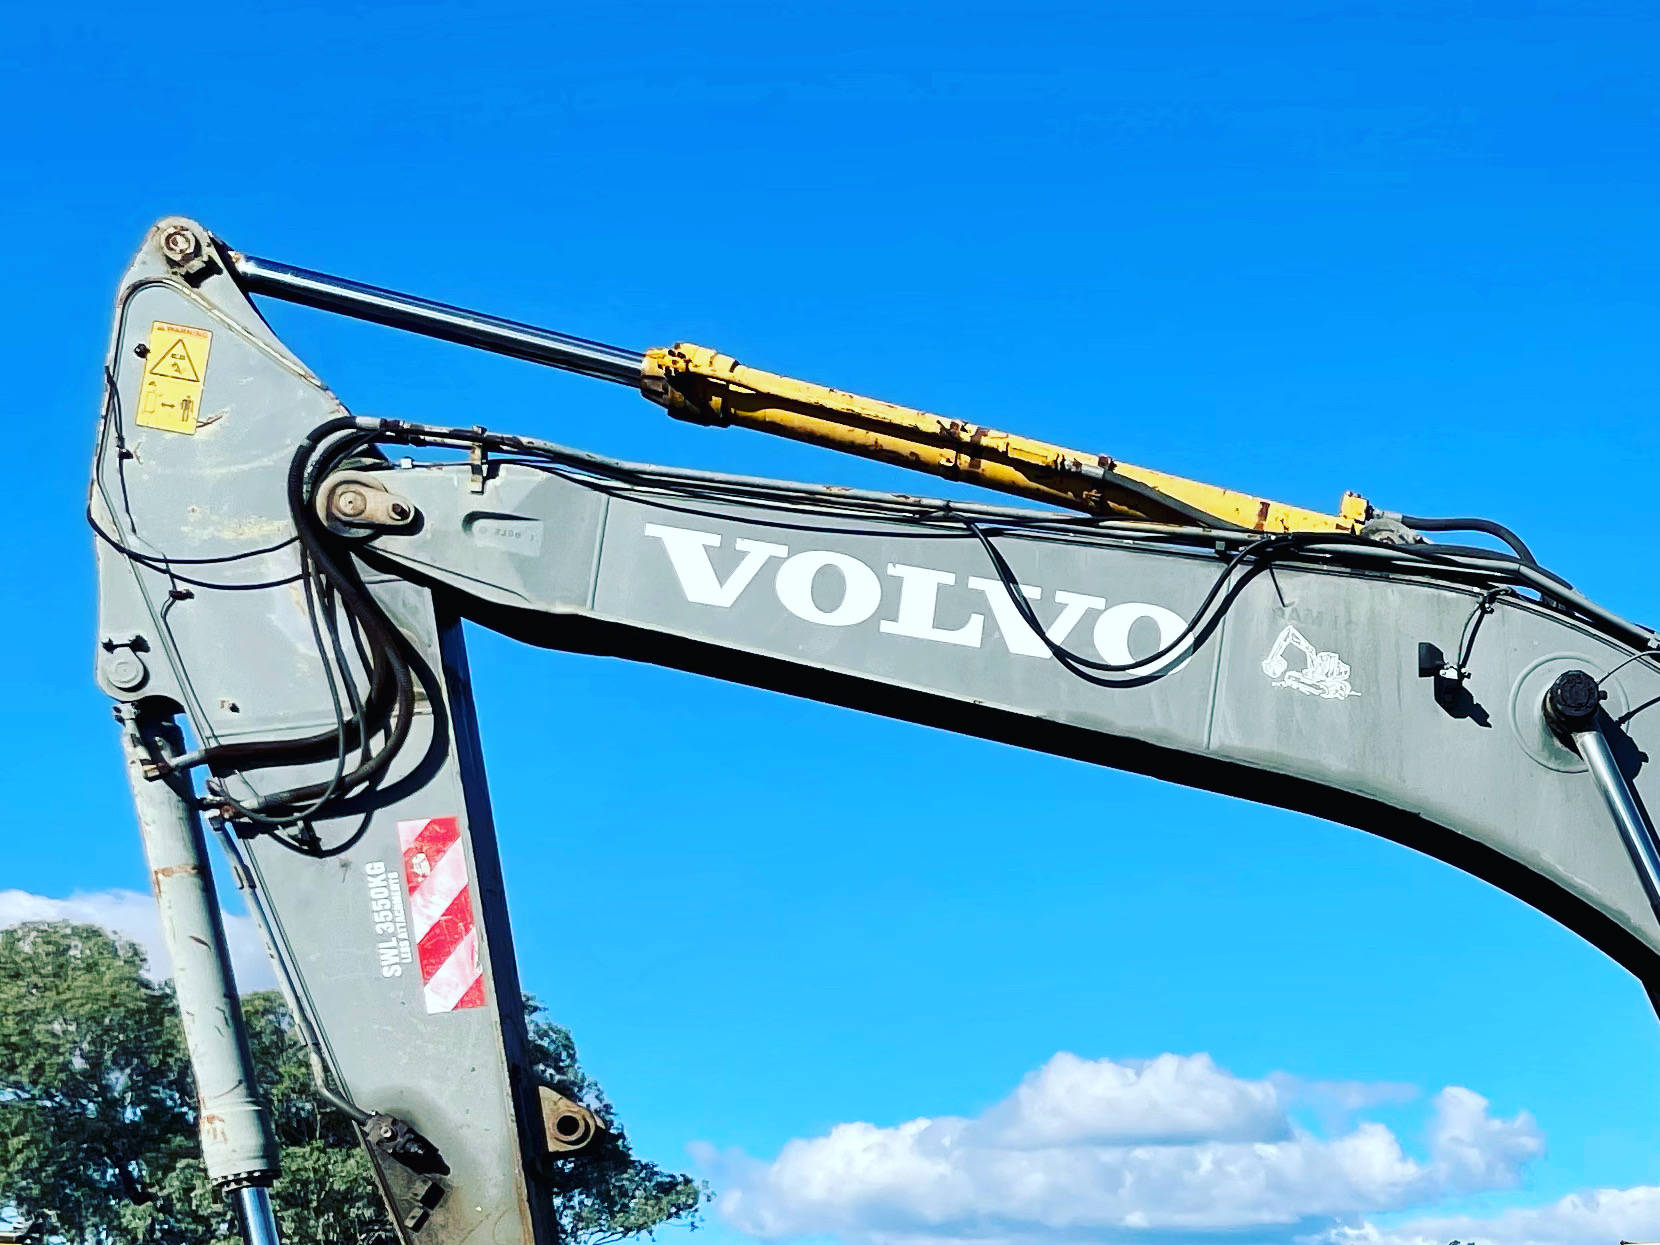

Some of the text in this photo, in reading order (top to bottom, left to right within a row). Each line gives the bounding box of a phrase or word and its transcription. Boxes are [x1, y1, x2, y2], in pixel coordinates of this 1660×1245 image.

[644, 522, 1196, 678] VOLVO
[365, 861, 402, 978] SWL 3550KG
[399, 940, 413, 964] LESS
